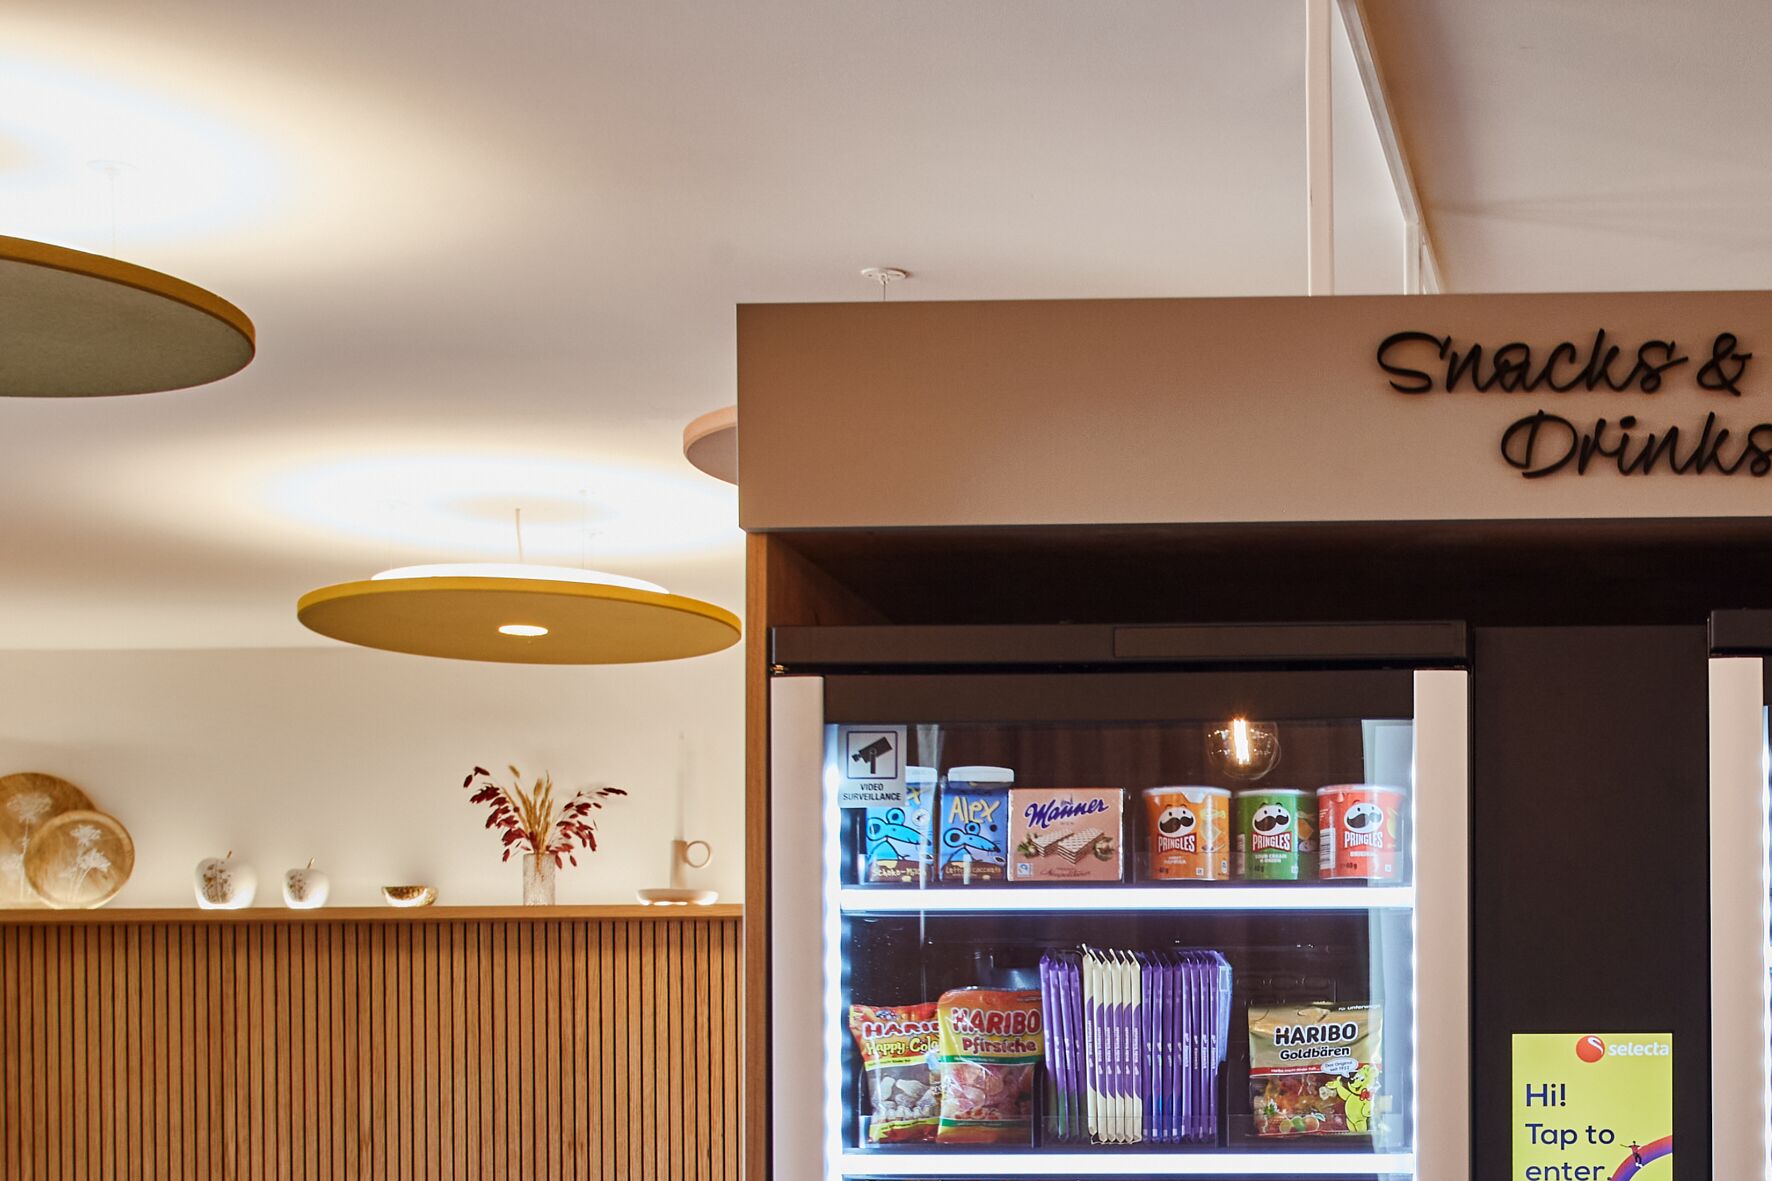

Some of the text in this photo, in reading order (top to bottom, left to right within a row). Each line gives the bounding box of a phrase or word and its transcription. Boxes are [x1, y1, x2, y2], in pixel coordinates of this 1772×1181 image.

[1377, 328, 1752, 396] Snacks &
[860, 783, 884, 791] VIDEO
[843, 793, 901, 801] SURVEILLANCE
[948, 795, 1000, 824] Alex
[1024, 799, 1110, 829] Manner
[1158, 834, 1195, 852] PRINGLES
[1252, 833, 1291, 852] PRINGLES
[1344, 831, 1383, 848] PRINGLES
[952, 1009, 1042, 1034] HARIBO
[1275, 1022, 1357, 1045] HARIBO
[962, 1037, 1037, 1055] Pfirsiche
[1280, 1047, 1350, 1060] Goldbären
[1607, 1041, 1670, 1056] selecta
[1525, 1083, 1566, 1107] Hi!
[1525, 1123, 1615, 1150] Tap to
[1525, 1162, 1612, 1181] enter.
